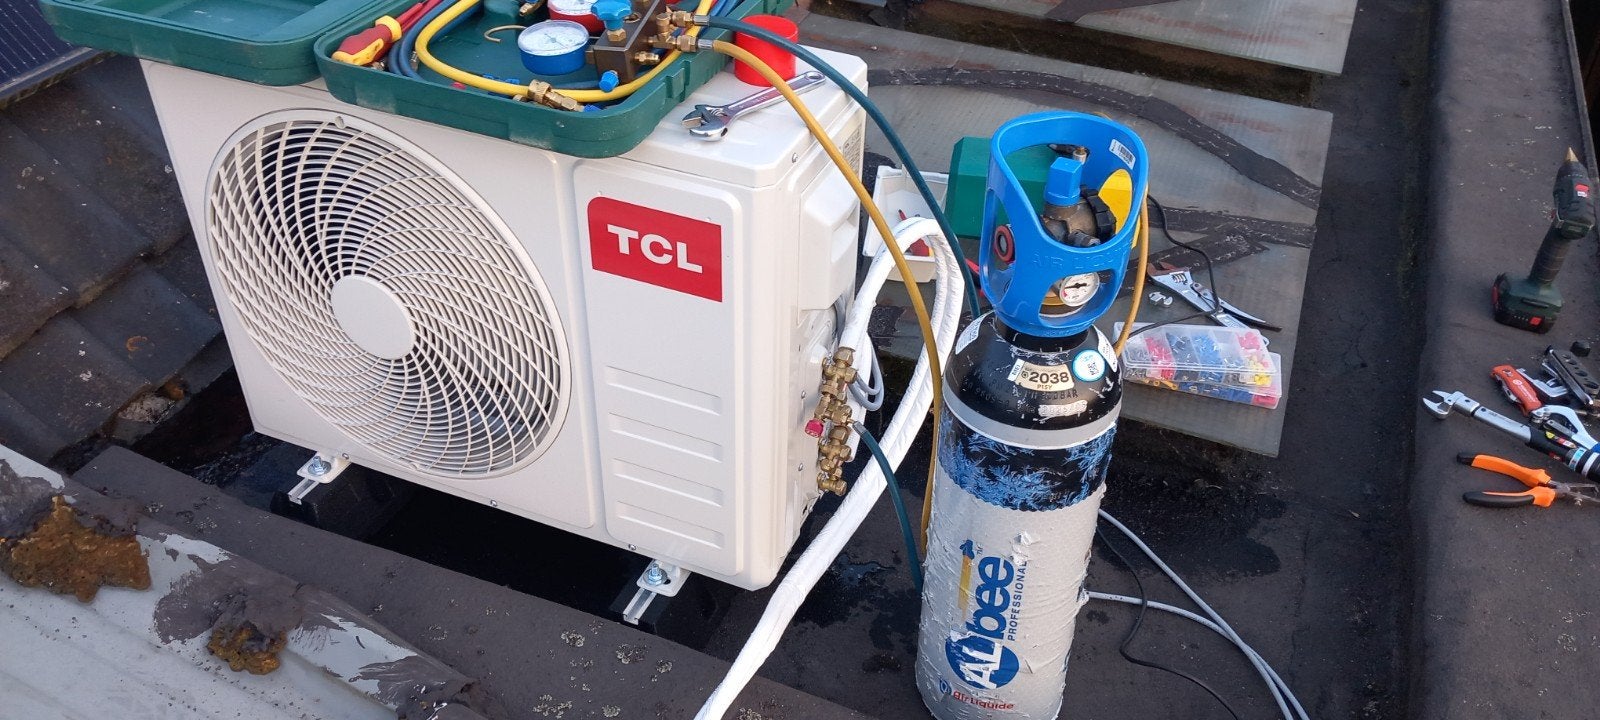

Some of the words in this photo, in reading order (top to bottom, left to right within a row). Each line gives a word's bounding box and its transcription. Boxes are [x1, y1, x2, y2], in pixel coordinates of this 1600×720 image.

[606, 223, 703, 274] TCL
[1028, 371, 1070, 385] 2038
[1008, 560, 1028, 642] PROFESSIONAL
